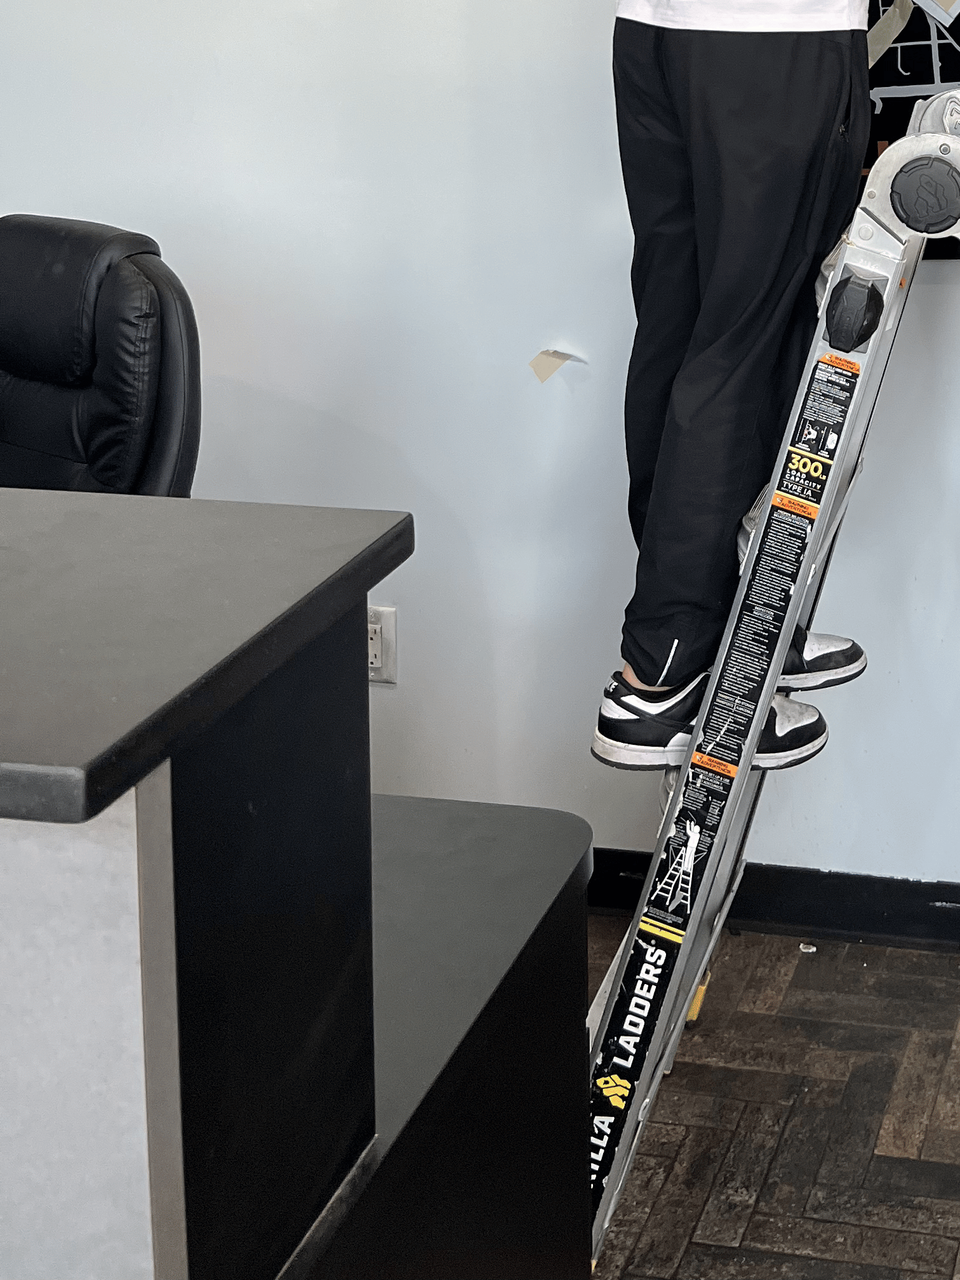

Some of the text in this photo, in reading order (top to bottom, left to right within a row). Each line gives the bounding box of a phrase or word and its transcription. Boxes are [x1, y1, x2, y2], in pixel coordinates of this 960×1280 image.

[786, 468, 807, 479] LOAD
[788, 453, 823, 478] 300
[782, 480, 803, 493] TYPE
[785, 473, 822, 490] CAPACITY
[613, 945, 667, 1068] LADDERS
